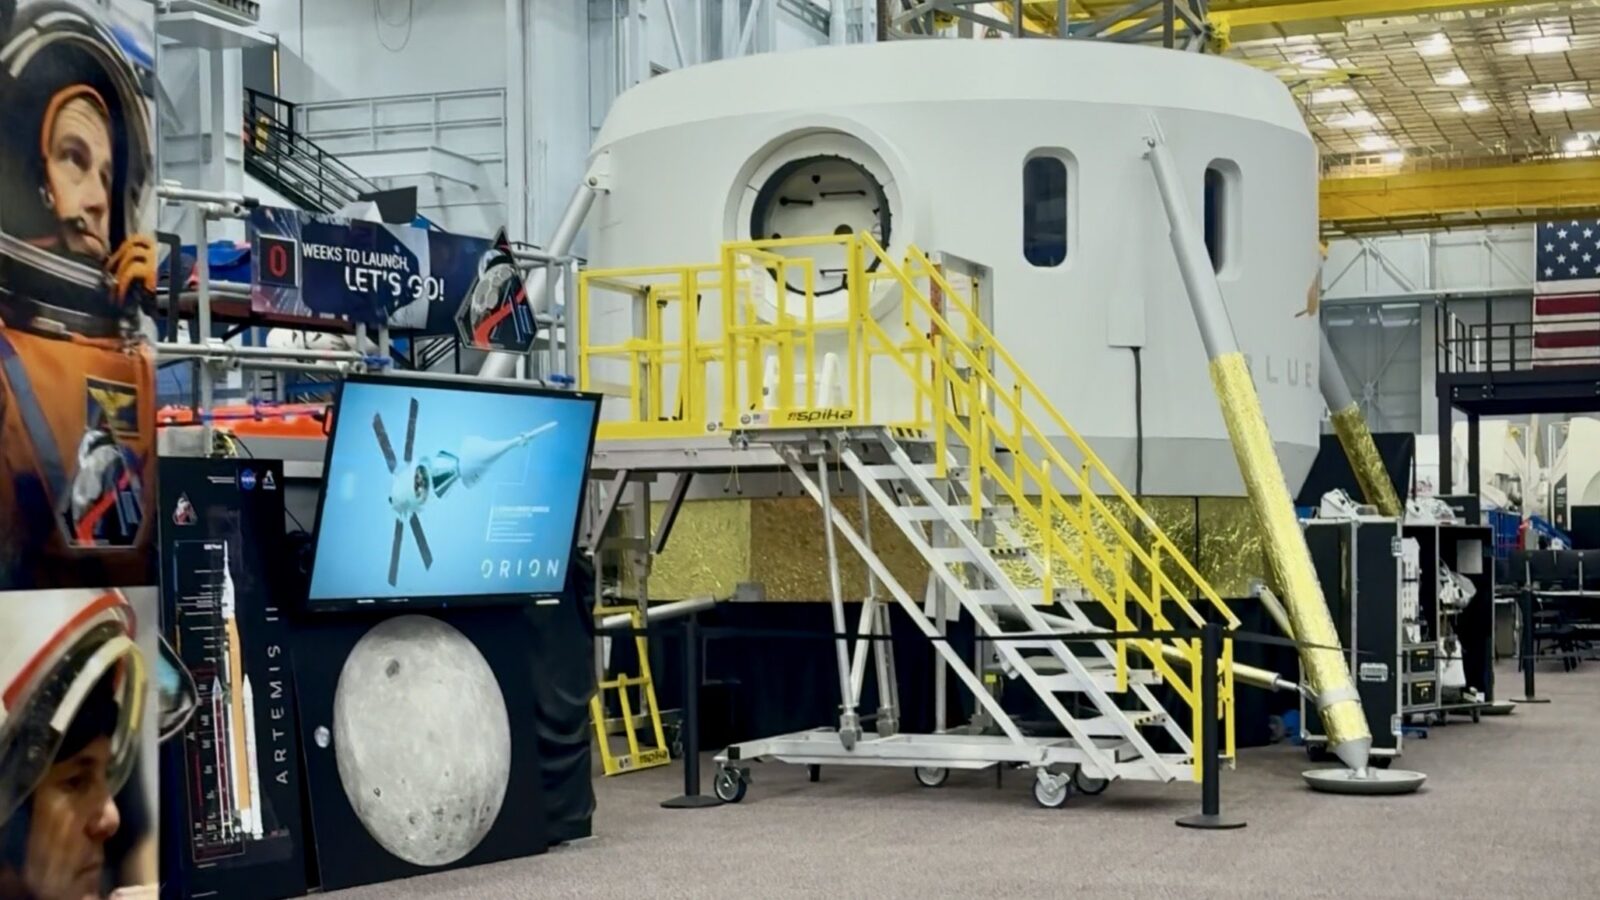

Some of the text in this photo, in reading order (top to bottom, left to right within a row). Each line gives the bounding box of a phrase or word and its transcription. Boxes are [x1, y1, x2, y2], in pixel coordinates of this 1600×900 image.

[302, 242, 342, 261] WEEKS
[344, 247, 360, 264] TO
[344, 266, 445, 301] LET'S GO!
[481, 559, 559, 578] ORION
[267, 645, 288, 784] ARTEMIS
